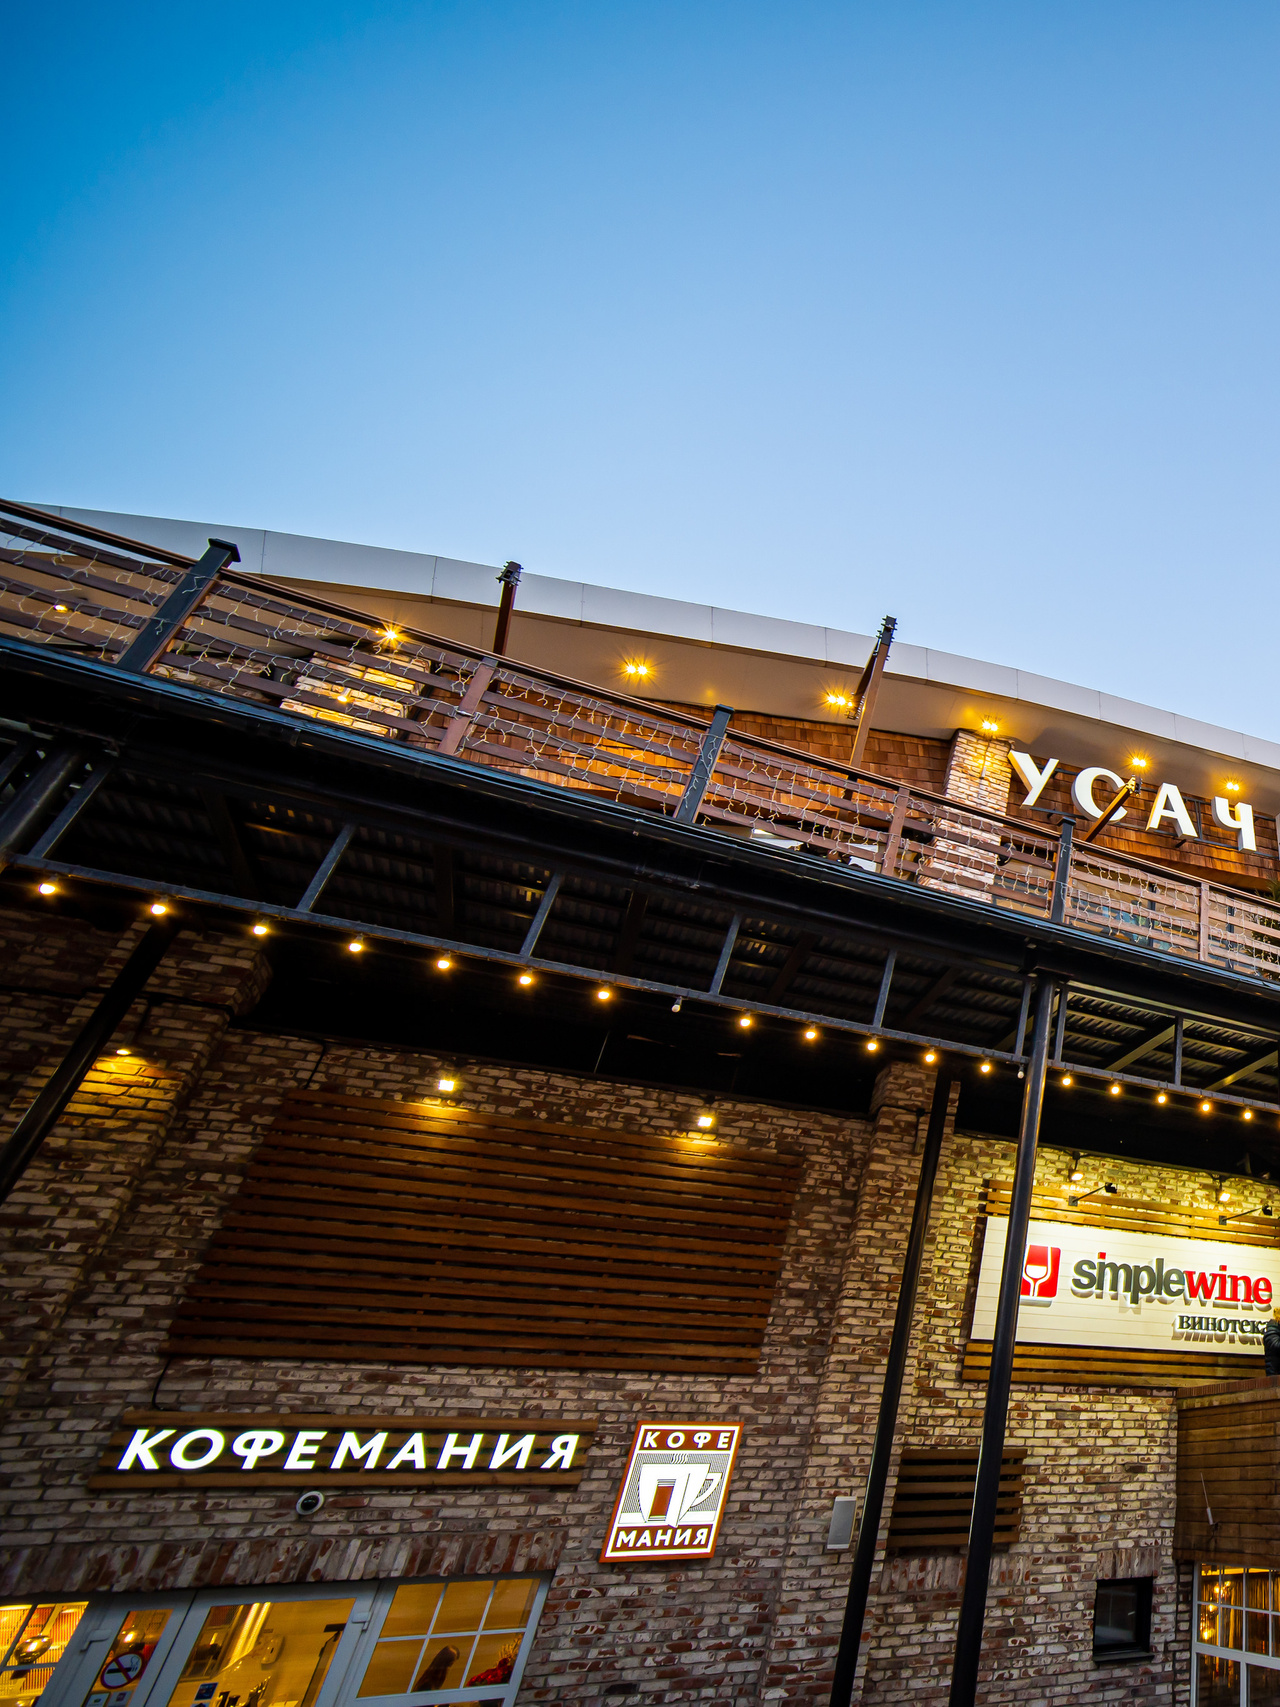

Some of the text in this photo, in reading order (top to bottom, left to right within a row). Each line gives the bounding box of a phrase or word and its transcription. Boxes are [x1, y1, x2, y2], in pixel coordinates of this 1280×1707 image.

[1073, 1253, 1272, 1304] simplewine
[117, 1428, 580, 1471] КОФЕМАНИЯ
[644, 1431, 731, 1448] КОФЕ
[616, 1529, 708, 1548] МАНИЯ
